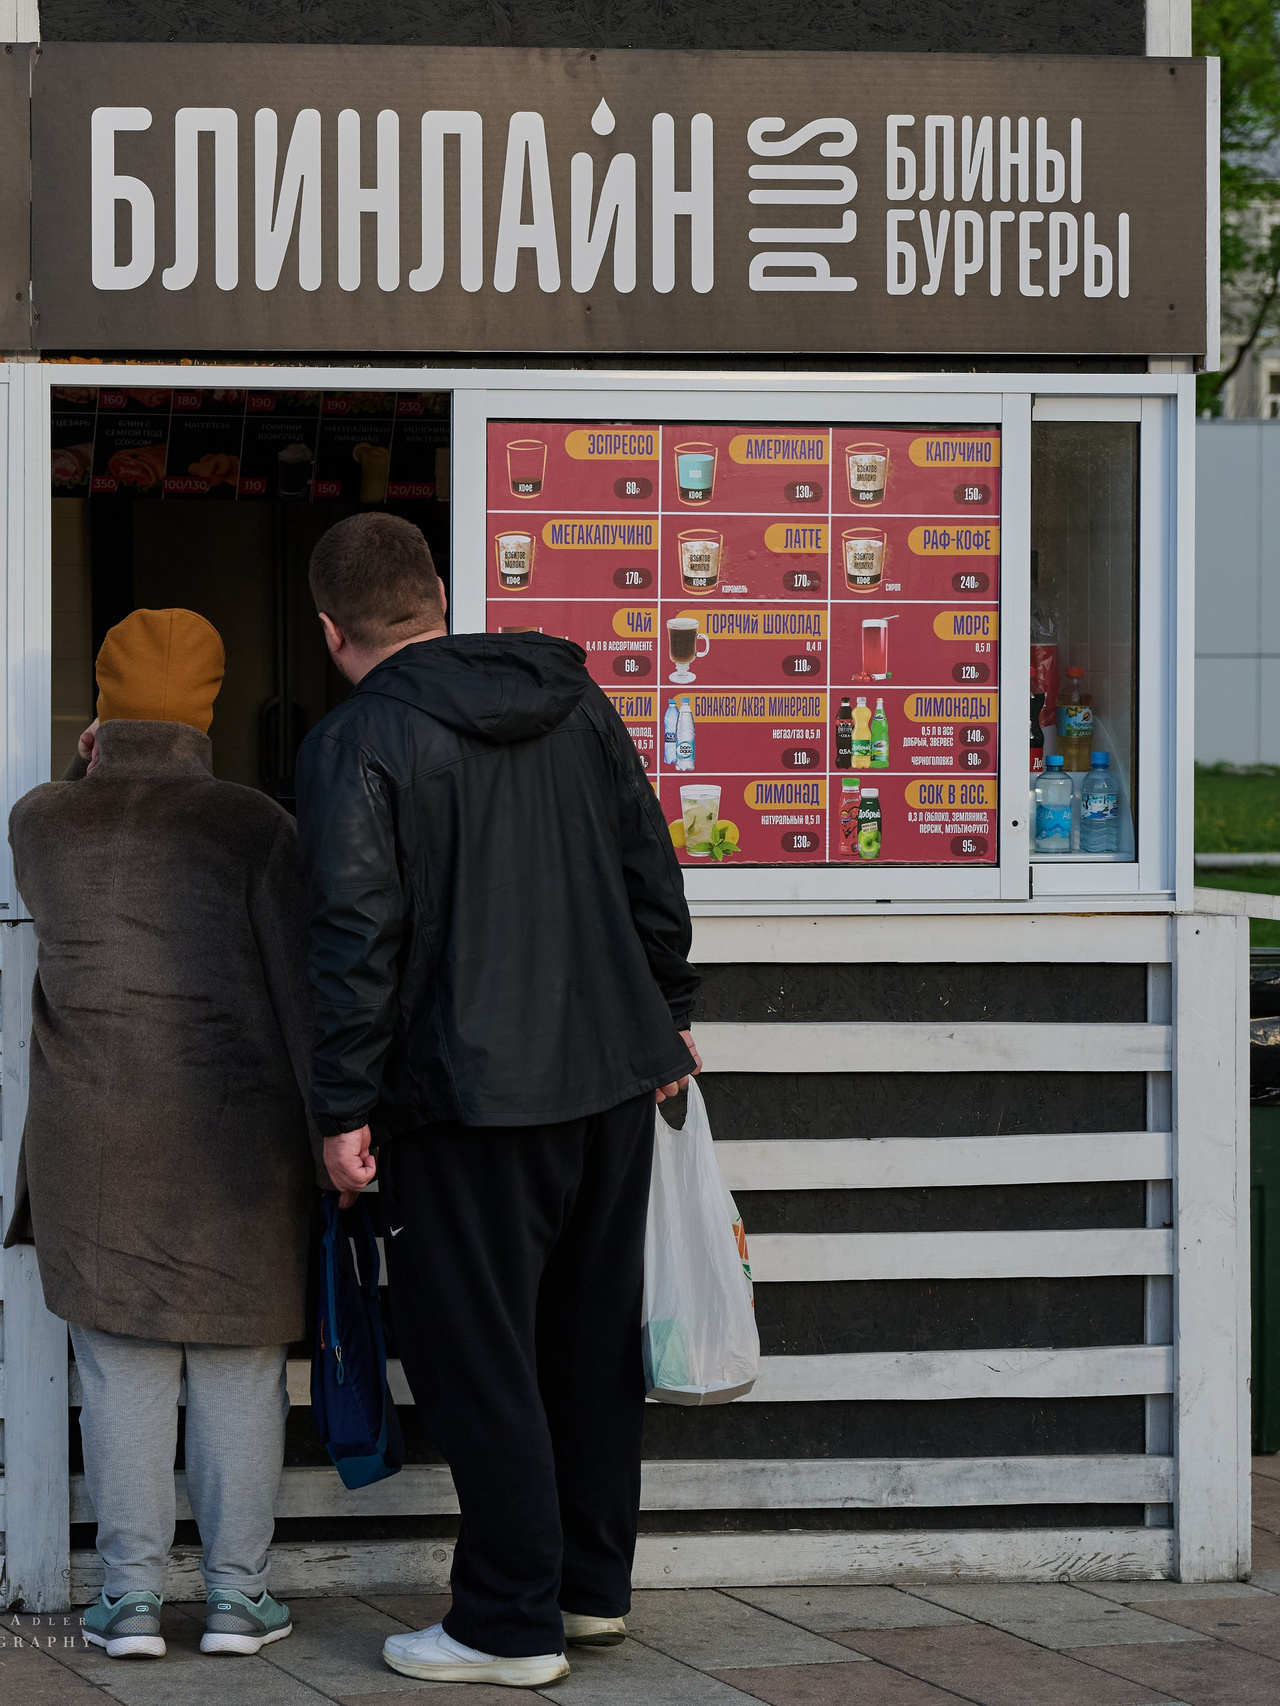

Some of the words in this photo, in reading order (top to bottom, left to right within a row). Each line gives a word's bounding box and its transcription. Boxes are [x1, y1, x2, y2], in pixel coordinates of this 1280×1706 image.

[886, 114, 1082, 204] БЛИНЫ
[91, 97, 714, 294] БЛИНЛАЙН
[746, 116, 858, 292] PLUS
[886, 208, 1130, 299] БУРГЕРЫ
[103, 395, 124, 405] 160
[177, 396, 198, 406] 180
[251, 398, 271, 407] 190
[327, 400, 346, 410] 190
[399, 402, 421, 411] 230
[588, 434, 653, 455] ЭСПРЕССО
[745, 438, 824, 460] АМЕРИКАНО
[926, 441, 992, 463] КАПУЧИНО
[94, 479, 115, 489] 350
[164, 480, 208, 491] 100/130
[244, 481, 261, 490] 110
[318, 483, 337, 493] 150
[388, 485, 430, 496] 120/150
[551, 524, 653, 546] МЕГАКАПУЧИНО
[784, 528, 822, 549] ЛАТТЕ
[923, 530, 991, 551] РАФ-КОФЕ
[627, 612, 652, 633] ЧАЙ
[706, 613, 759, 634] ГОРЯЧИЙ
[763, 614, 821, 636] ШОКОЛАД
[953, 615, 990, 636] МОРС
[608, 641, 653, 651] АССОРТИМЕНТЕ
[610, 696, 652, 717] ТЕЙЛИ
[914, 697, 991, 719] ЛИМОНАДЫ
[755, 783, 820, 806] ЛИМОНАД
[919, 784, 944, 805] СОК
[949, 784, 956, 804] В
